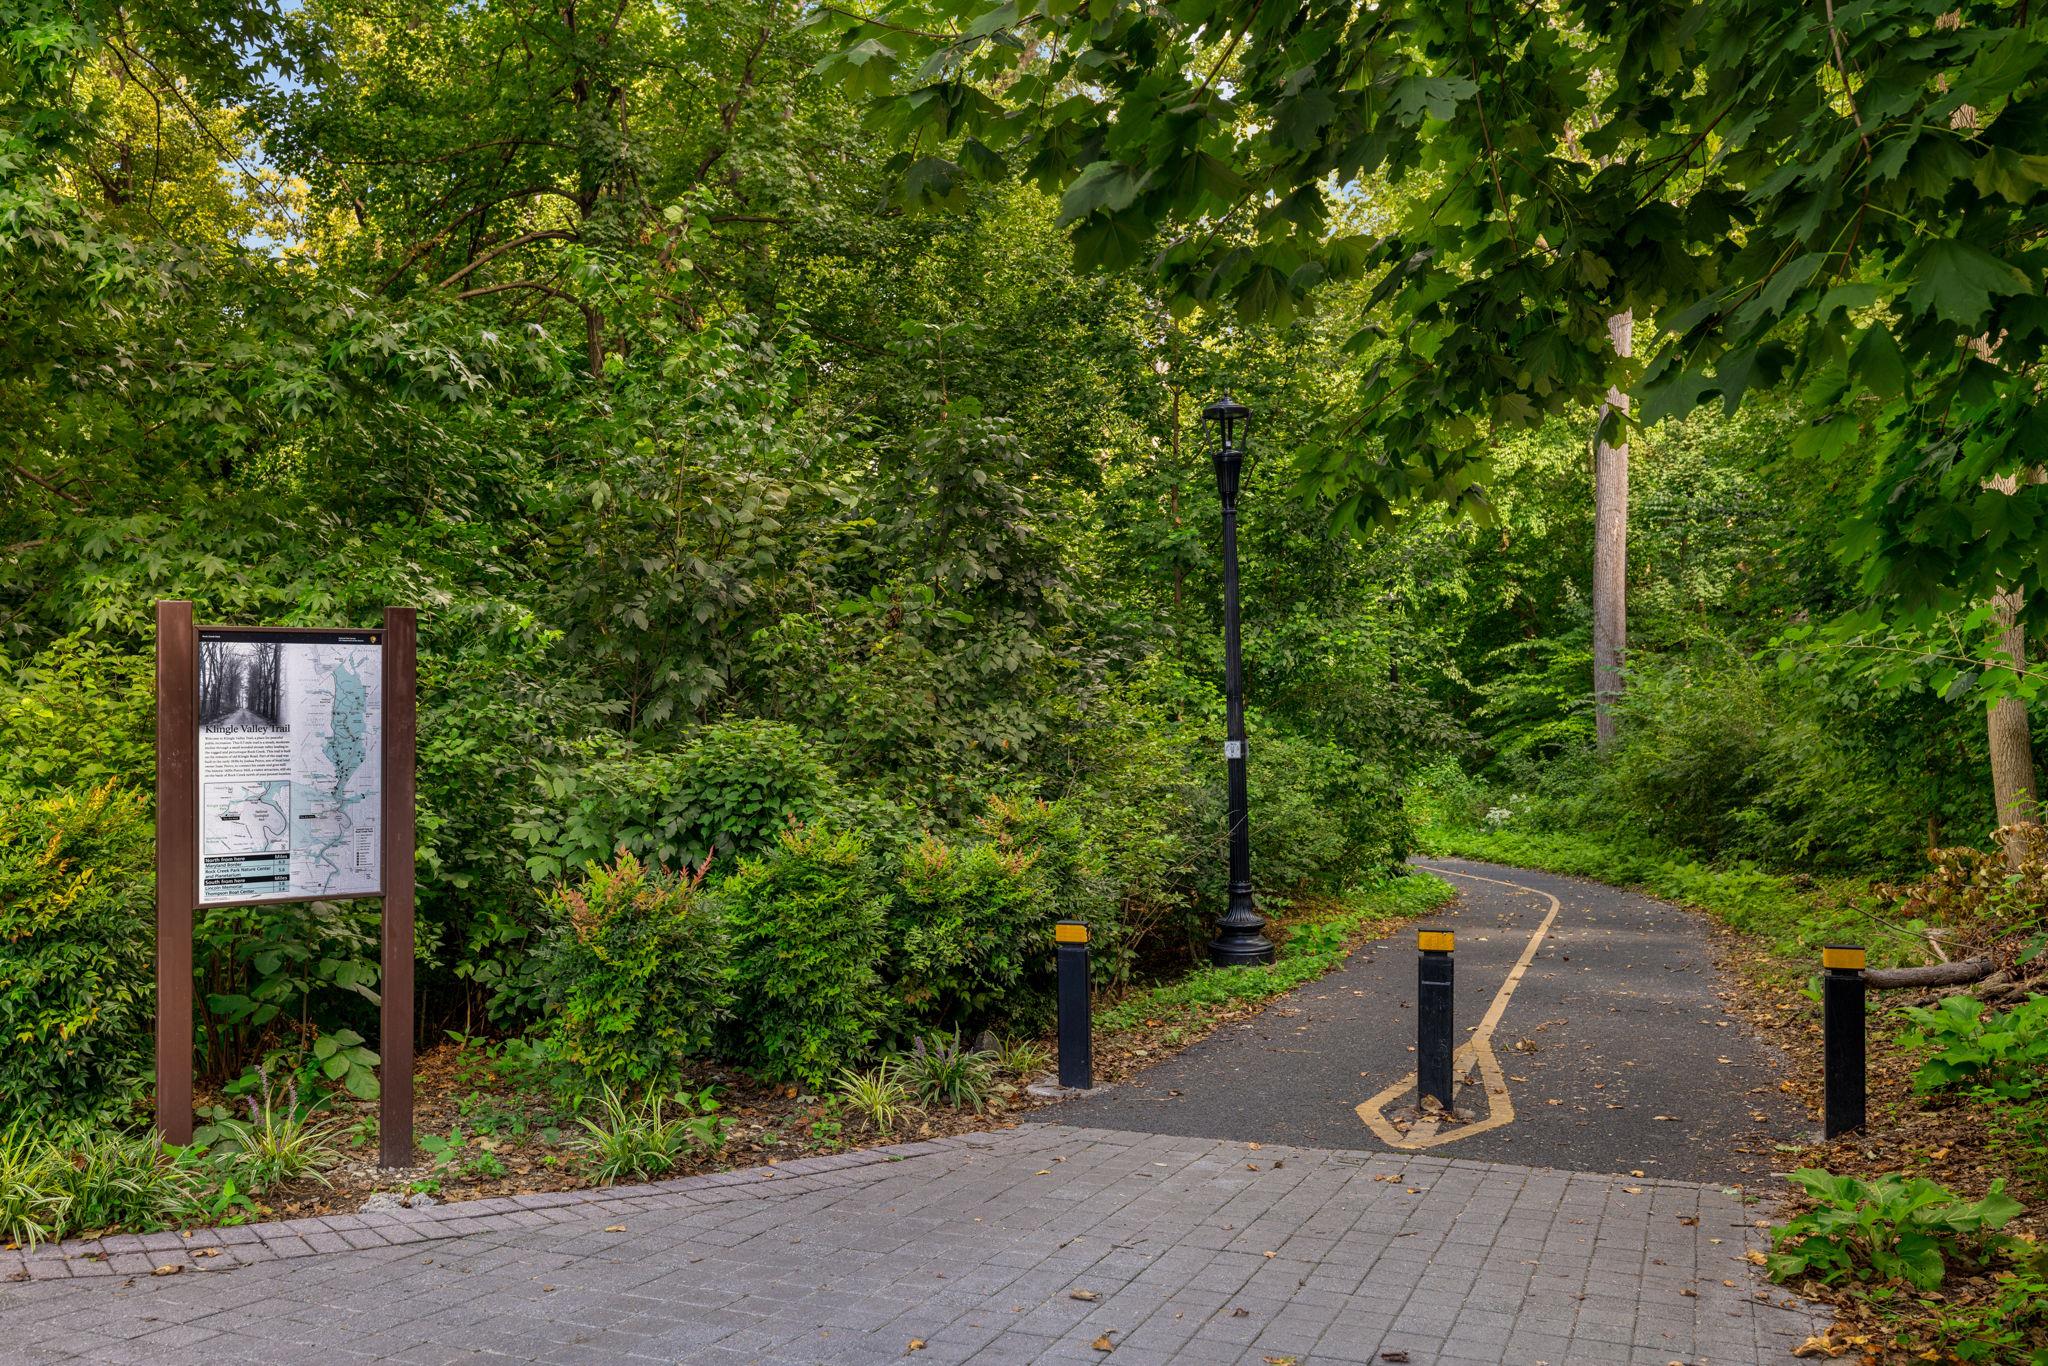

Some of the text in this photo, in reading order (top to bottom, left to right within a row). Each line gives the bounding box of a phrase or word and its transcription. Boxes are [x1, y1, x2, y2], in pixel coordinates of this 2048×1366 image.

[205, 724, 291, 735] Klingle Valley Trail
